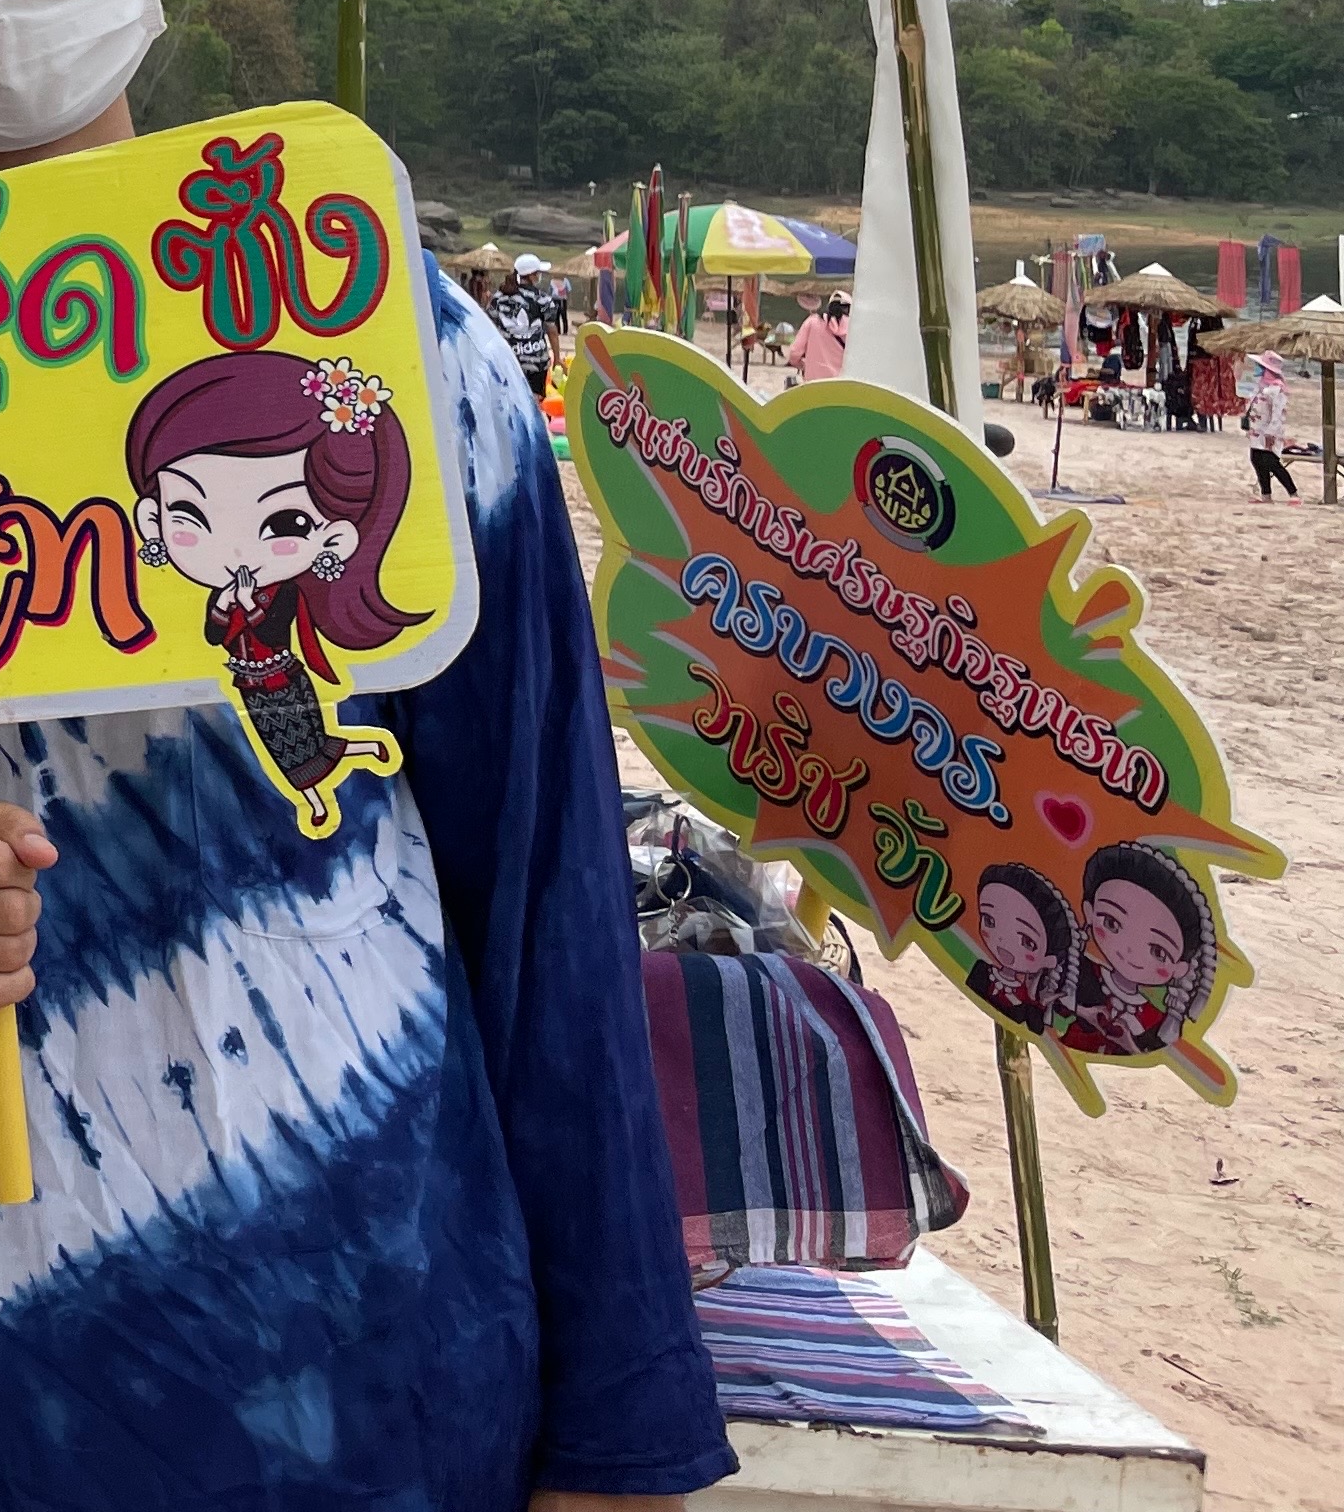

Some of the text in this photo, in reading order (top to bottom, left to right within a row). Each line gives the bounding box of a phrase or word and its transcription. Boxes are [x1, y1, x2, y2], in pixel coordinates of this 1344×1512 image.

[598, 385, 1166, 808] ศูนย์บริการเศรษฐกิจฐานราก
